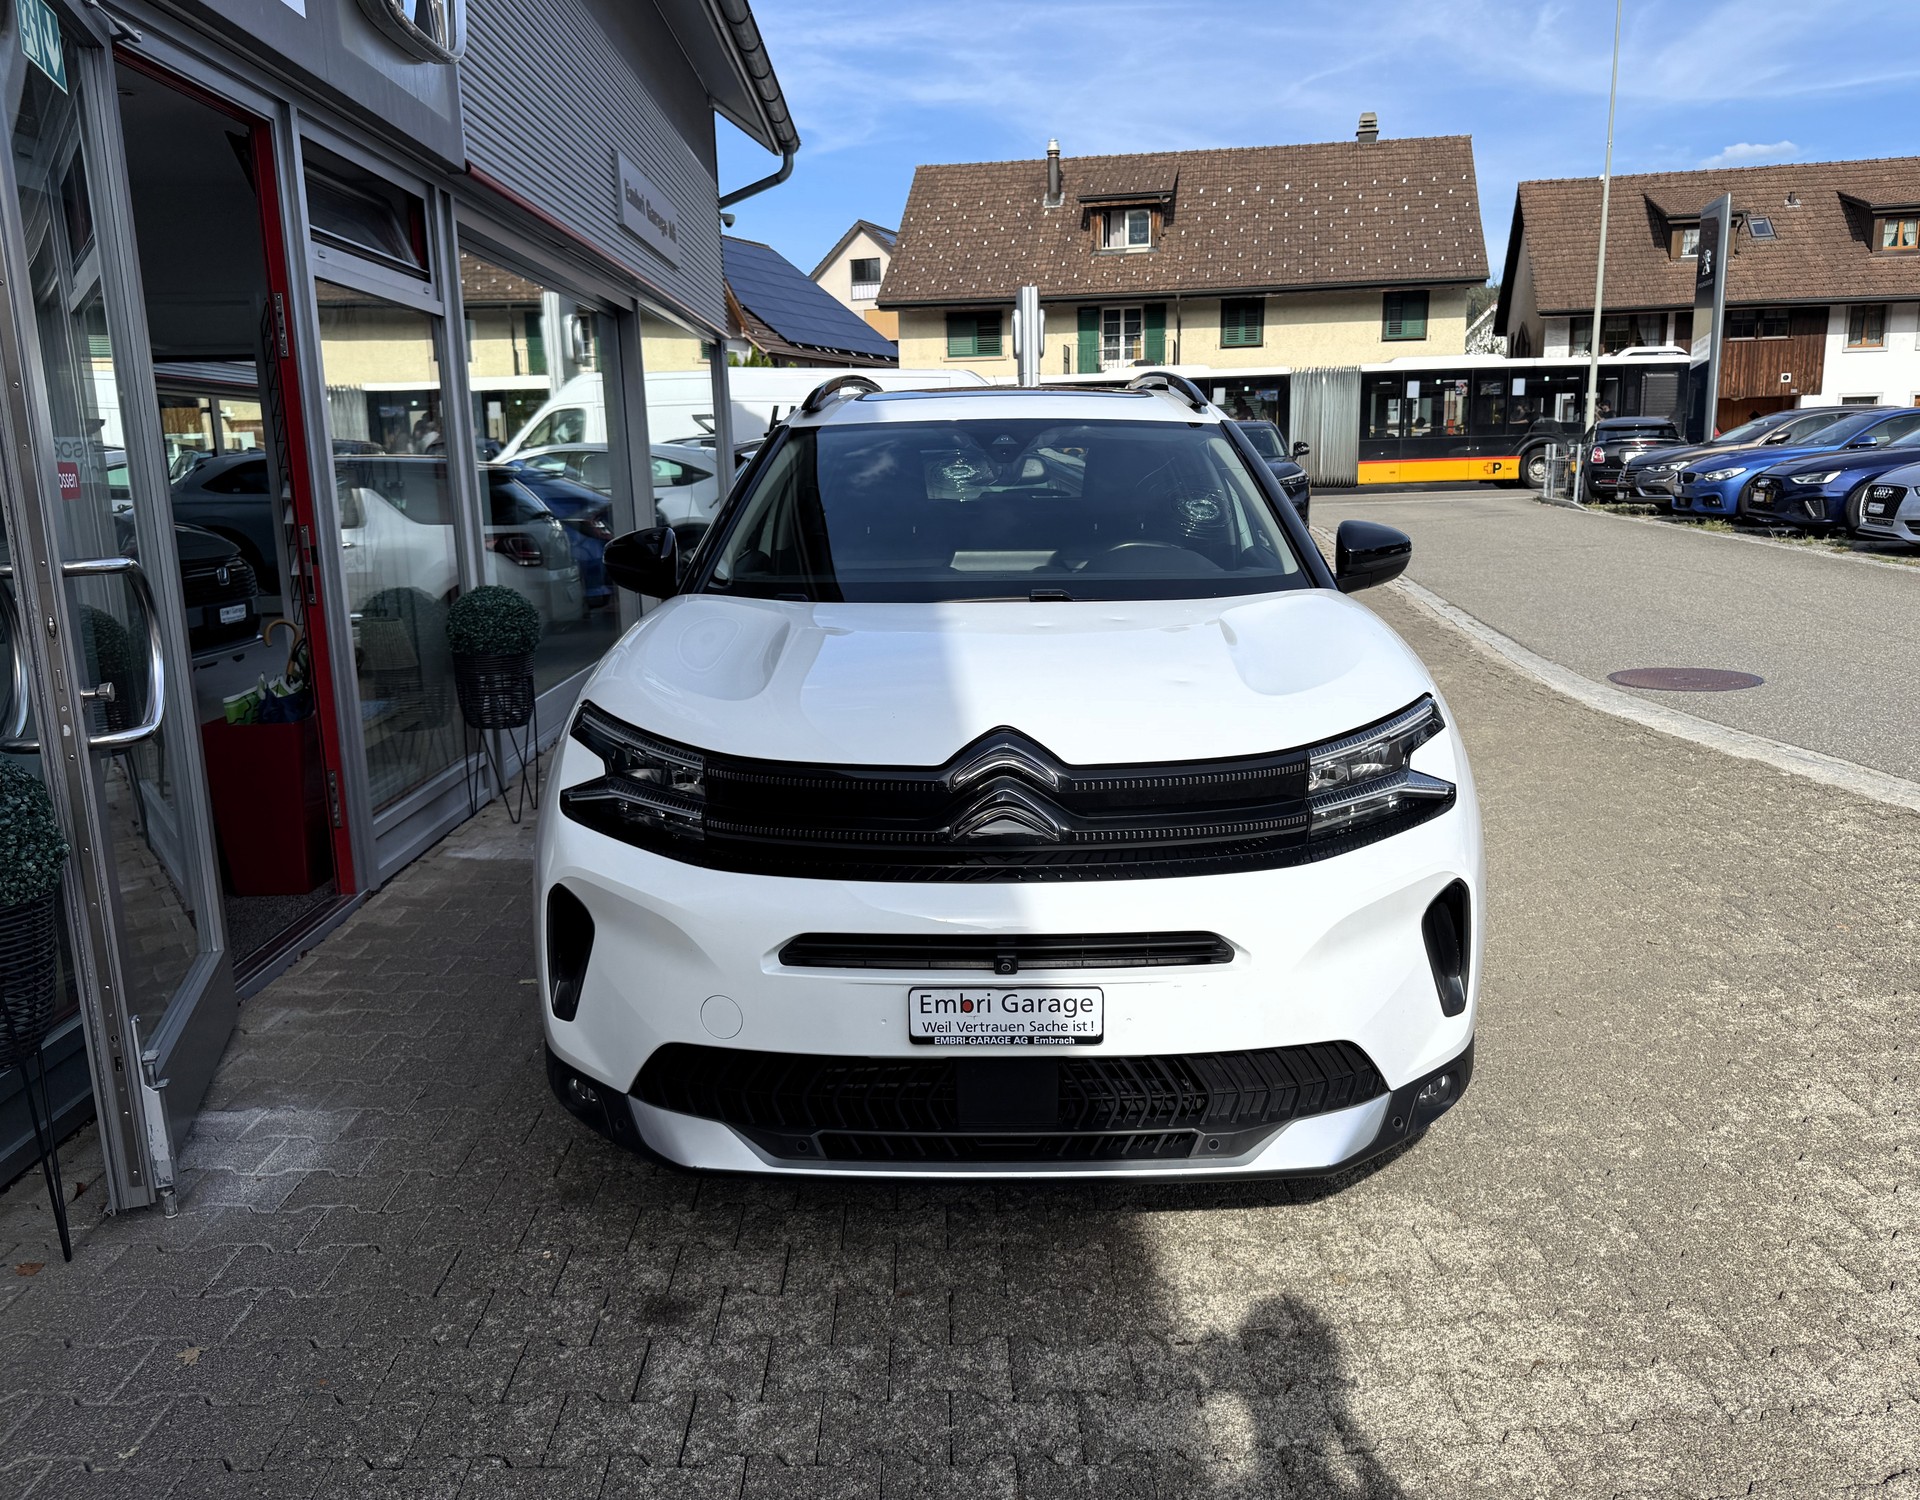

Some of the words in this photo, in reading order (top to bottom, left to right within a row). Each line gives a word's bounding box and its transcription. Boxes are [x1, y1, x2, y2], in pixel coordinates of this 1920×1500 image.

[920, 993, 991, 1014] Embri
[1001, 993, 1094, 1018] Garage
[922, 1021, 952, 1033] Weil
[956, 1021, 1025, 1033] Vertrauen
[1029, 1020, 1069, 1032] Sache
[934, 1036, 1011, 1045] EMBRI-GARAGE
[1013, 1036, 1029, 1045] AG
[1033, 1036, 1075, 1045] Embrach
